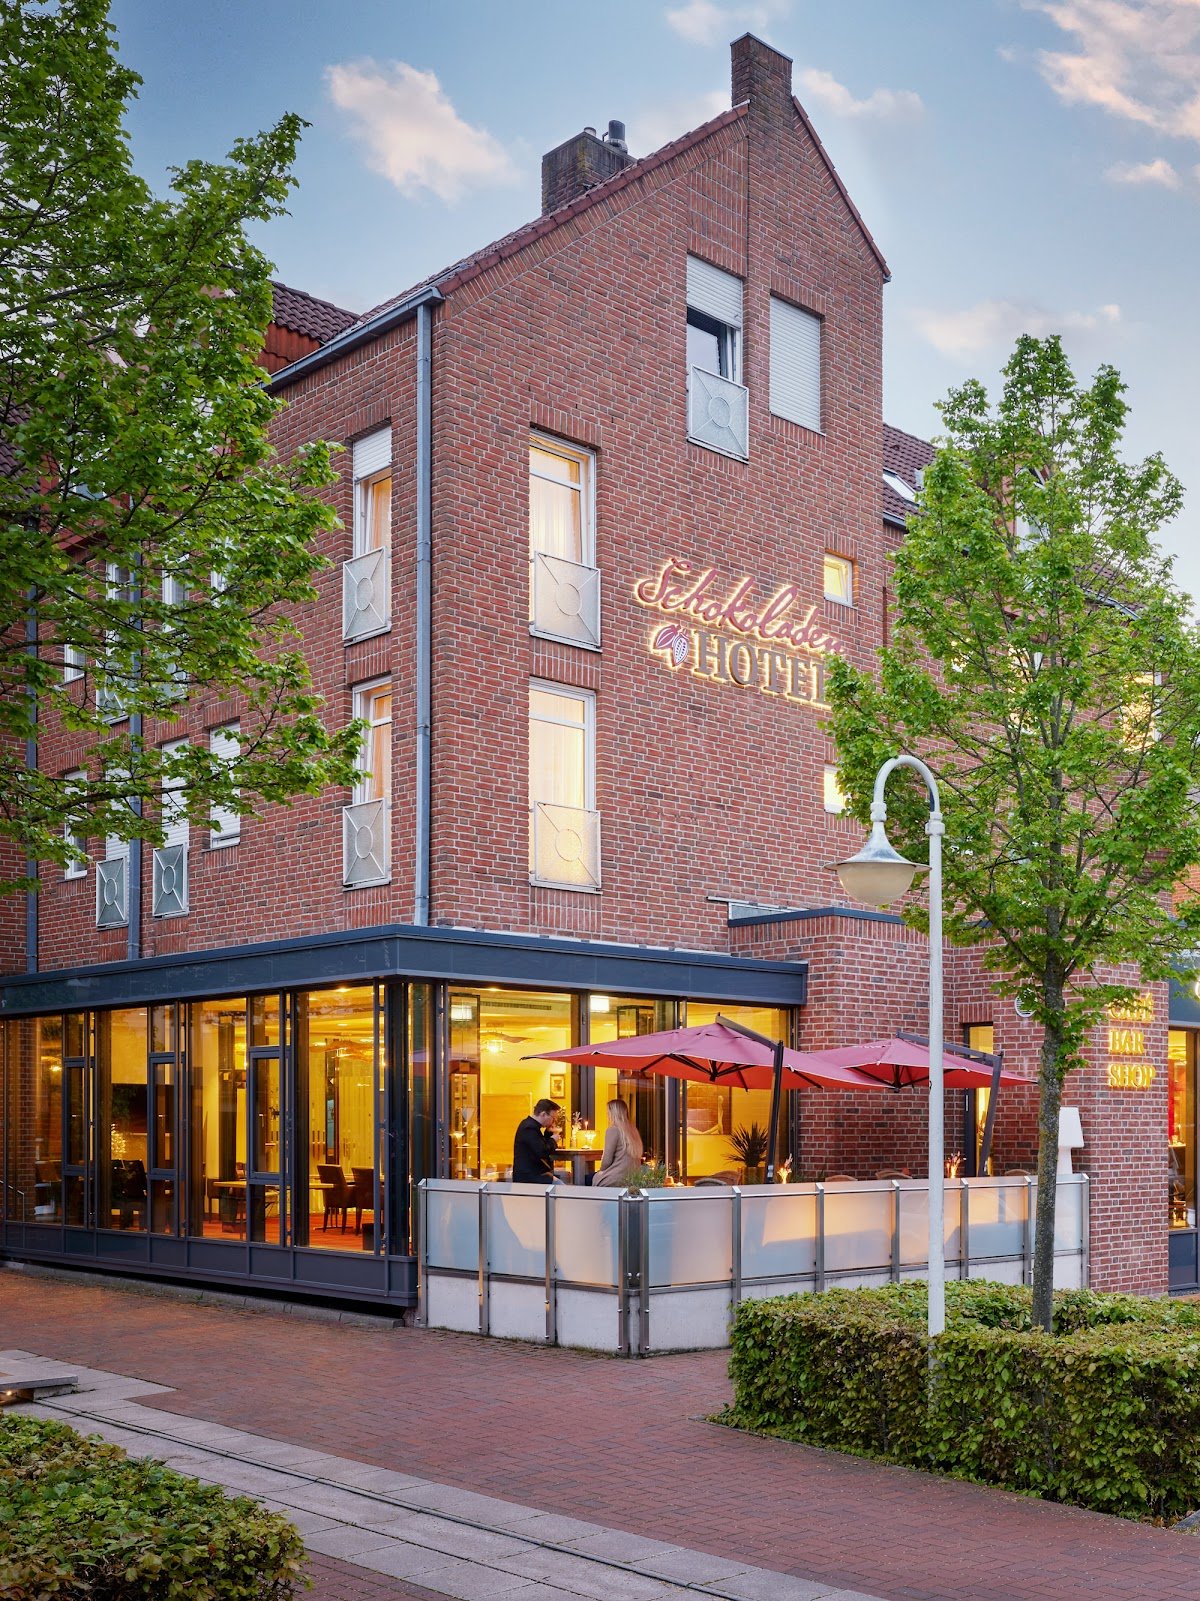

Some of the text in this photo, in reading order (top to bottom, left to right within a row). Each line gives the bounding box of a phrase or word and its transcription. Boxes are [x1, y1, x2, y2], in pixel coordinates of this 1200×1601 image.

[637, 557, 847, 654] Schokoladen
[1108, 1029, 1145, 1056] BAR
[1107, 1063, 1157, 1088] SHOP
